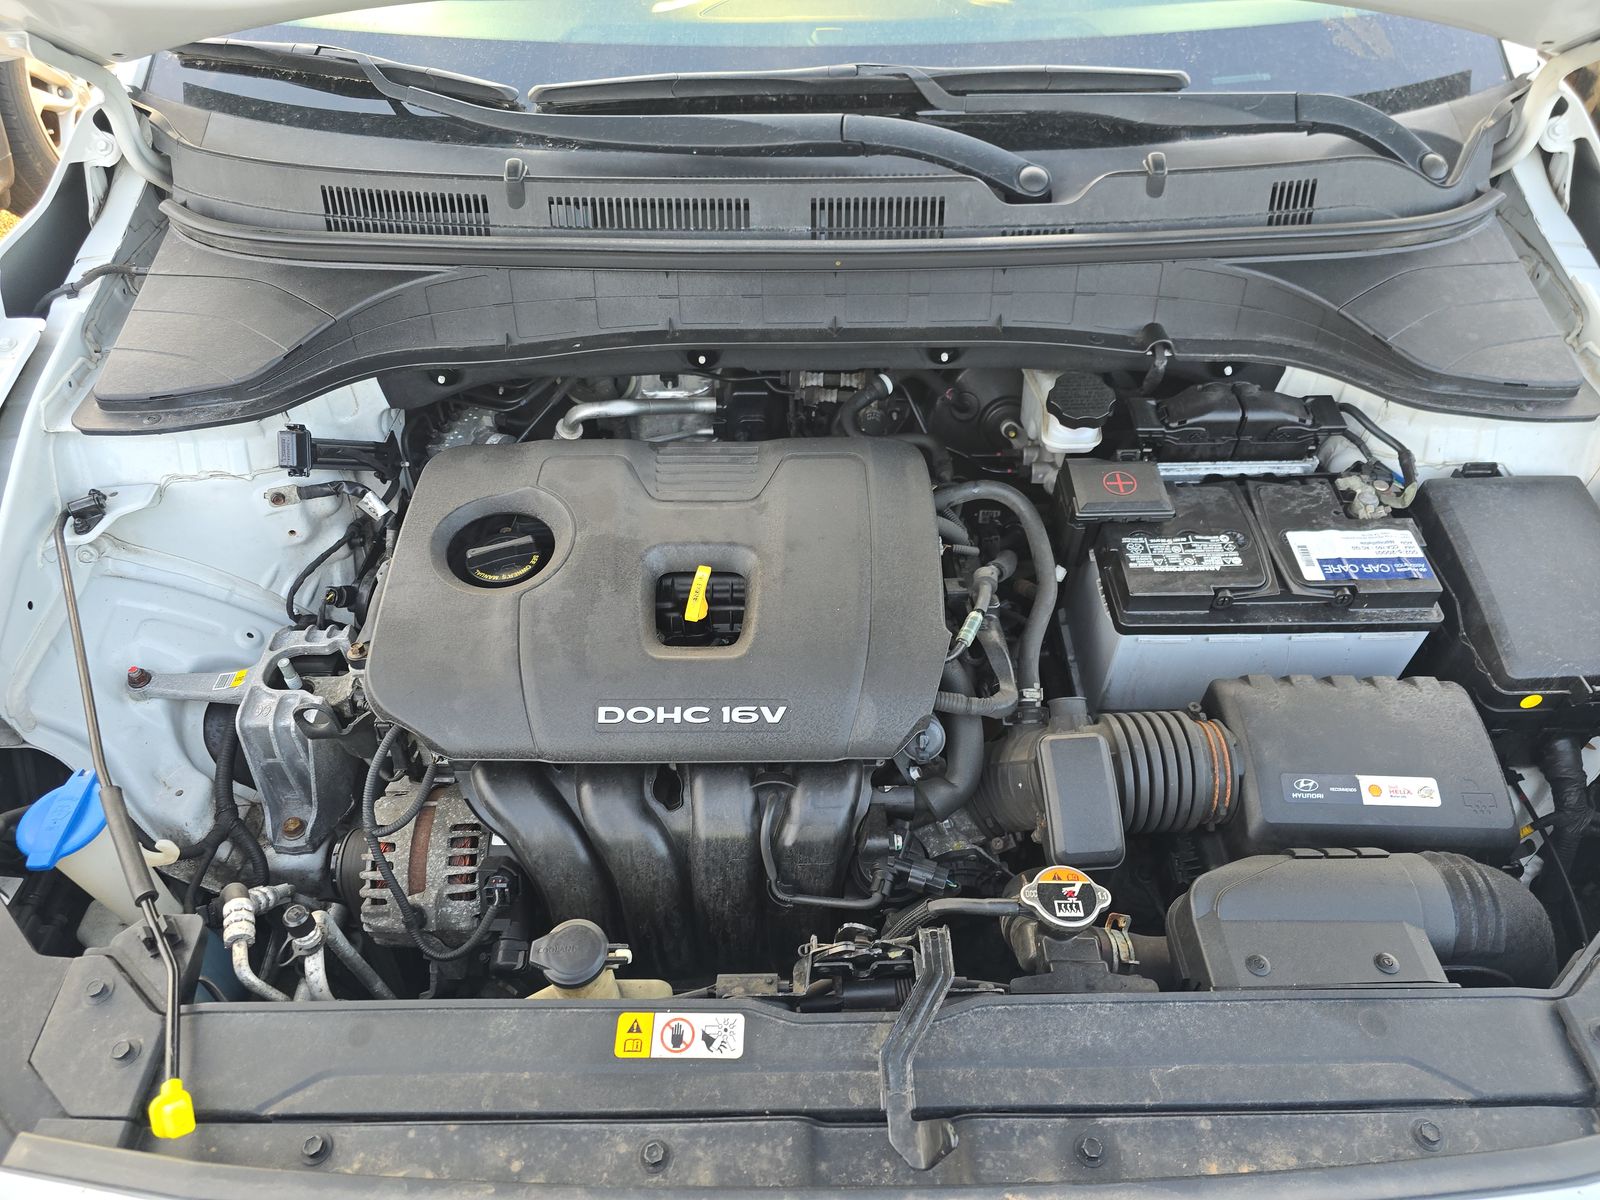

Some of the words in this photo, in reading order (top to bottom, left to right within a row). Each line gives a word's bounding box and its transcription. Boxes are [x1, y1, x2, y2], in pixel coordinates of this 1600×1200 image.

[529, 554, 539, 565] SEE
[1322, 563, 1360, 574] CARE
[1363, 563, 1391, 573] CAR
[474, 569, 500, 580] MANUAL
[597, 706, 710, 724] DOHC
[721, 706, 787, 724] 16V
[1097, 891, 1108, 900] 1.1
